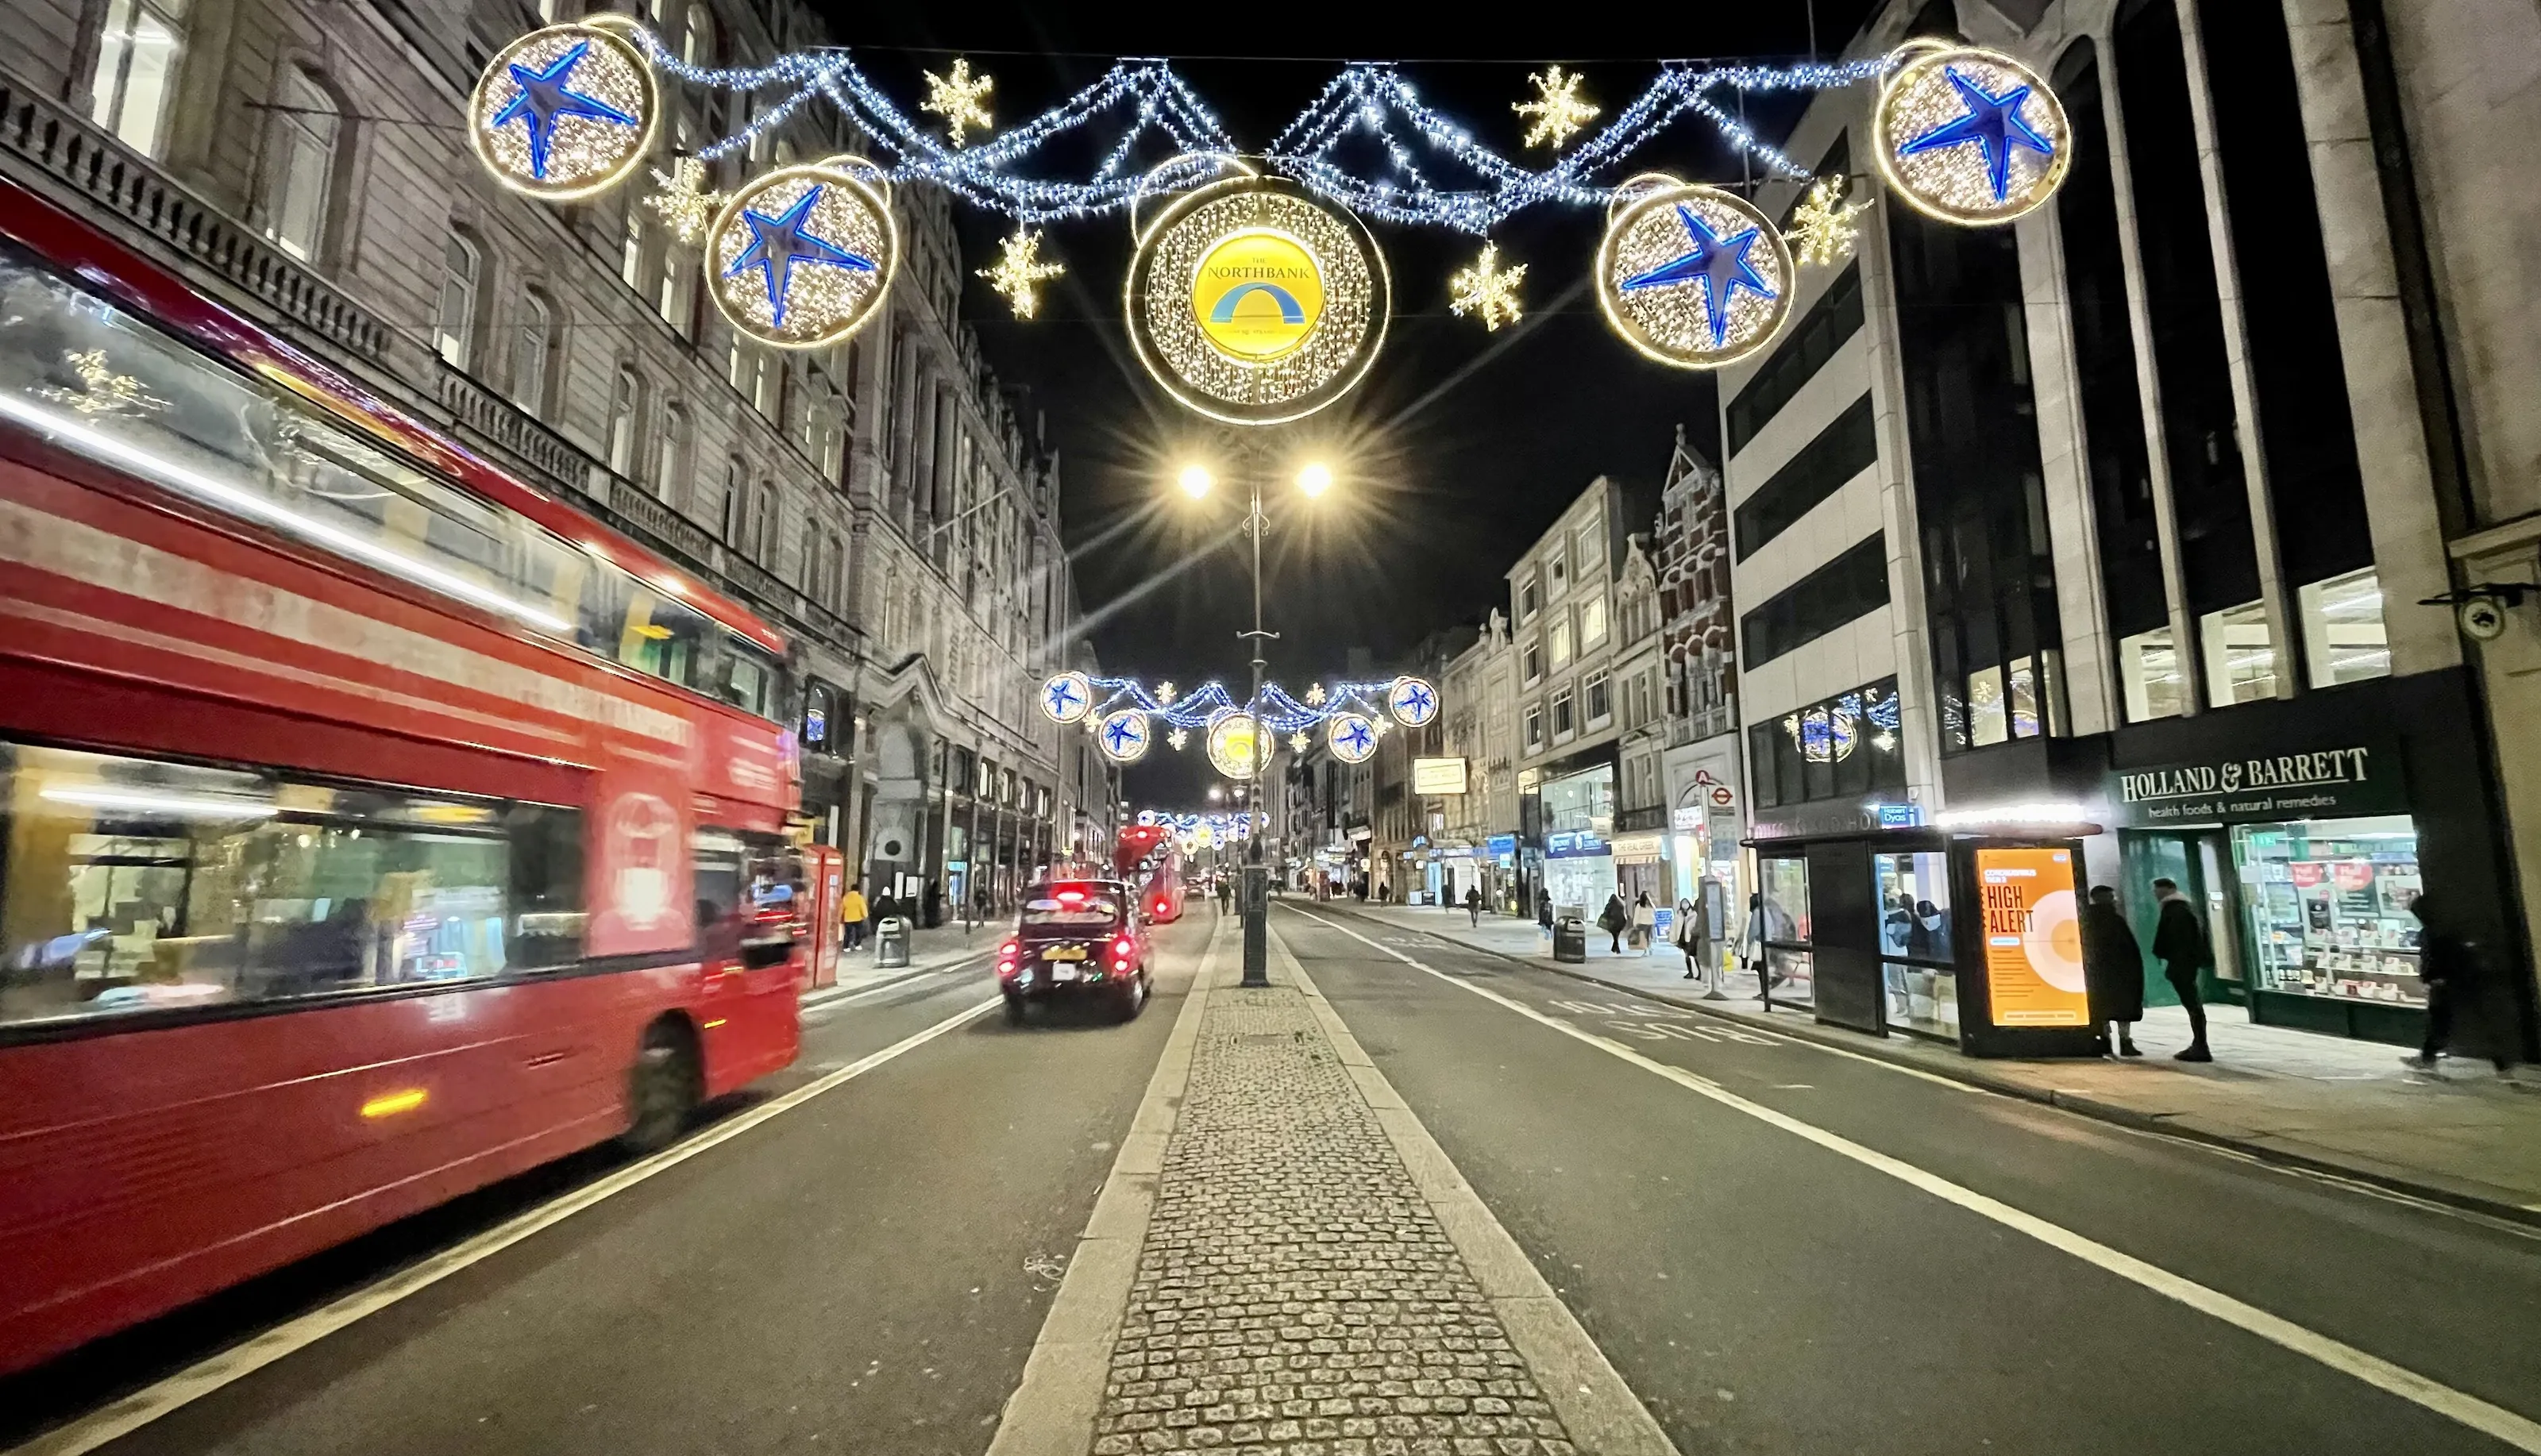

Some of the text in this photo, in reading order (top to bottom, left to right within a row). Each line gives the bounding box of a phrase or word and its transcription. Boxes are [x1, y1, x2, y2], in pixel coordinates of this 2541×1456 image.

[1208, 267, 1310, 279] NORTHBANK
[1698, 771, 1709, 782] A
[2120, 746, 2369, 803] HOLLAND & BARRETT
[1884, 813, 1906, 822] Dyas
[2149, 795, 2337, 819] health foods & natural remedies
[1987, 886, 2024, 908] HIGH
[1990, 910, 2034, 933] ALERT
[1602, 1020, 1783, 1046] BUS
